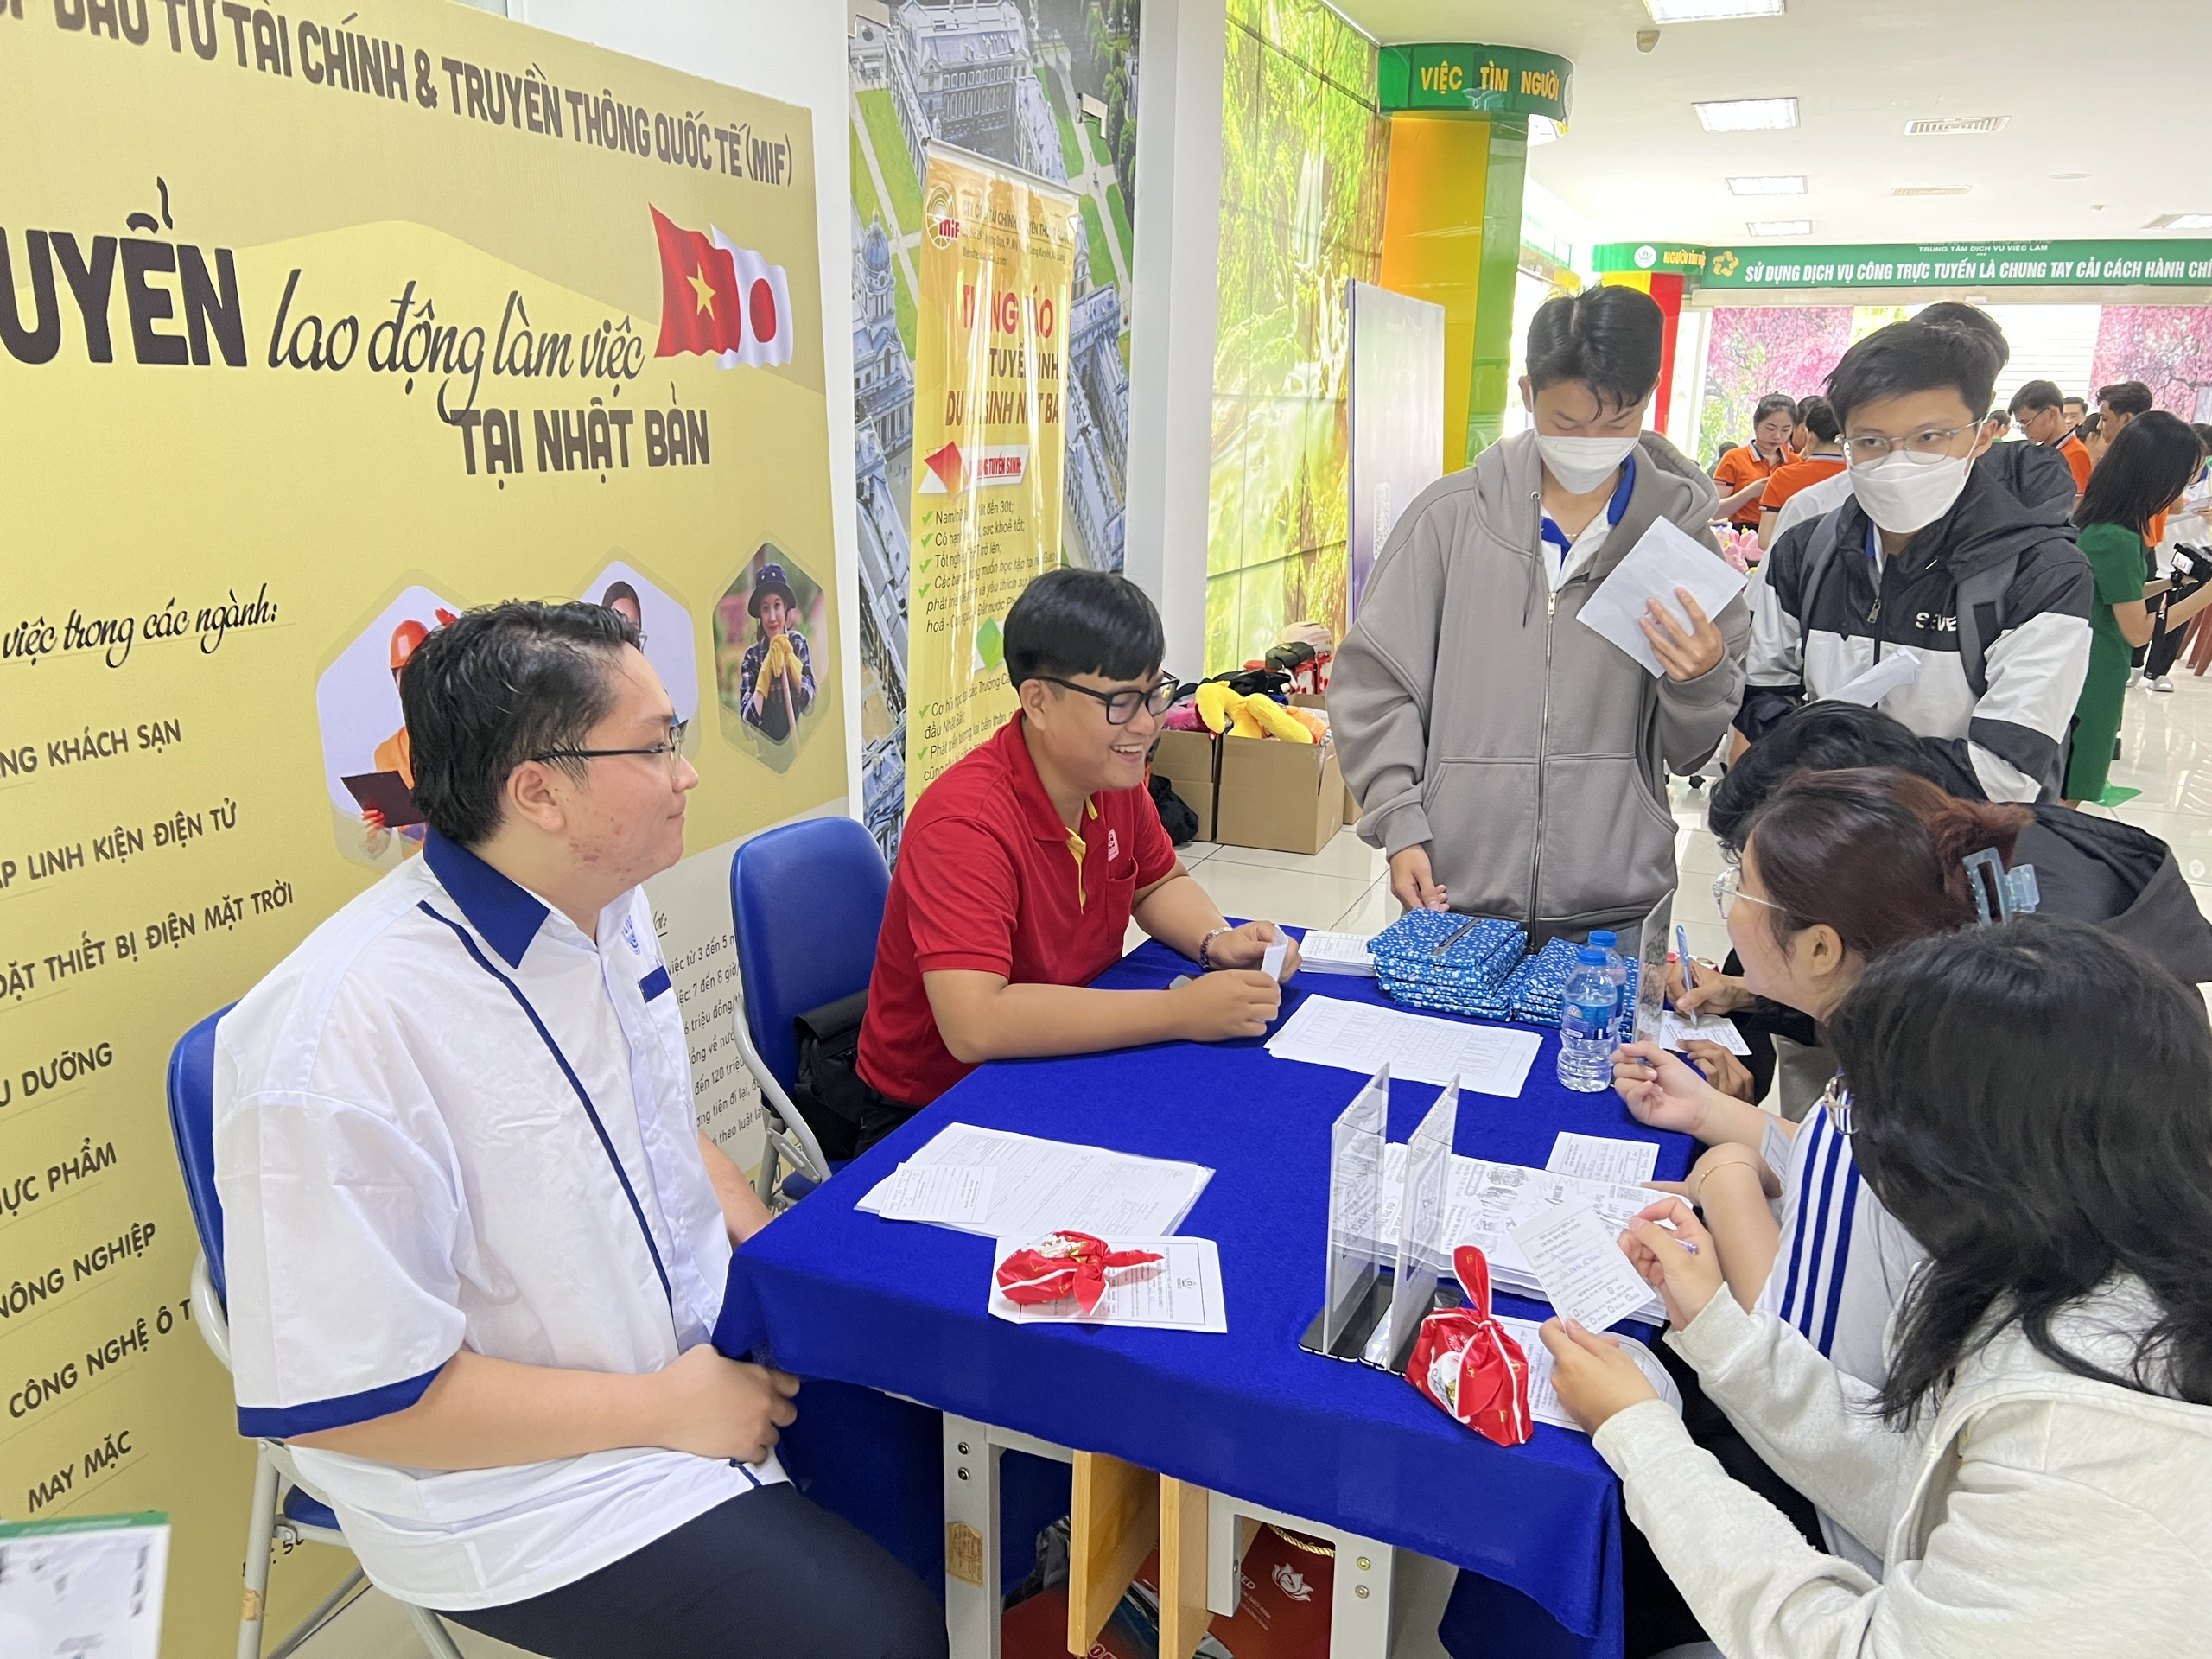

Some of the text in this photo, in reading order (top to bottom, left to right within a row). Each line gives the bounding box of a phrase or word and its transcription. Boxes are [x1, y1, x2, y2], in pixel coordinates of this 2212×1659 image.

[1421, 60, 1560, 101] VIỆC TÌM NGƯỜI
[298, 12, 407, 103] CHÍNH
[415, 49, 439, 109] &
[442, 58, 563, 139] TRUYỀN
[566, 88, 651, 156] THÔNG
[655, 111, 713, 172] QUỐC
[715, 120, 748, 179] TẾ
[745, 123, 793, 188] (MIF)
[1663, 249, 1688, 264] NGƯỜI
[1745, 261, 1764, 282] SỬ
[1765, 264, 1800, 285] DỤNG
[1802, 264, 1834, 285] DỊCH
[1837, 264, 1854, 284] VỤ
[1857, 260, 1893, 280] CÔNG
[1897, 263, 1930, 283] TRỰC
[1934, 257, 1976, 279] TUYẾN
[1979, 259, 1995, 278] LÀ
[1999, 261, 2046, 278] CHUNG
[2050, 261, 2074, 277] TAY
[2075, 256, 2101, 277] CẢI
[2103, 257, 2142, 277] CÁCH
[2144, 257, 2185, 277] HÀNH
[268, 269, 359, 372] lao
[367, 280, 486, 426] động
[493, 290, 575, 380] làm
[579, 315, 646, 397] việc
[945, 390, 964, 426] DU
[451, 382, 710, 491] TẠI NHẬT BẢN
[987, 499, 999, 516] đến
[936, 531, 947, 547] Có
[982, 524, 994, 537] sức
[935, 550, 949, 568] Tốt
[935, 575, 950, 590] Các
[982, 559, 998, 575] muốn
[1000, 558, 1012, 572] học
[1014, 556, 1024, 571] tập
[927, 595, 948, 615] phát
[1000, 577, 1017, 592] thích
[3, 582, 279, 669] việc trong các ngành:
[927, 618, 944, 633] hoá
[931, 702, 944, 716] Cơ
[47, 726, 129, 767] KHÁCH
[137, 718, 181, 753] SẠN
[27, 842, 84, 880] LINH
[93, 825, 144, 863] KIỆN
[153, 810, 203, 848] ĐIỆN
[209, 798, 238, 830] TỬ
[43, 930, 105, 981] THIẾT
[115, 931, 138, 962] BỊ
[145, 912, 195, 950] ĐIỆN
[204, 894, 245, 933] MẶT
[251, 878, 295, 916] TRỜI
[687, 950, 696, 966] từ
[698, 947, 702, 961] 3
[705, 936, 721, 957] đến
[722, 935, 727, 948] 5
[692, 983, 697, 996] 7
[700, 971, 715, 993] đến
[717, 970, 722, 983] 8
[691, 1012, 710, 1030] triệu
[708, 1034, 717, 1053] về
[22, 1042, 113, 1097] DƯỠNG
[695, 1074, 709, 1096] đến
[711, 1066, 724, 1084] 120
[713, 1099, 728, 1116] tiện
[730, 1091, 737, 1106] đi
[719, 1127, 736, 1145] theo
[738, 1112, 753, 1130] luật
[0, 1137, 117, 1216] ỰC PHẨM
[73, 1222, 156, 1281] NGHIỆP
[9, 1363, 78, 1418] CÔNG
[86, 1318, 149, 1376] NGHỆ
[156, 1305, 173, 1335] Ô
[27, 1430, 132, 1514] MAY MẶC
